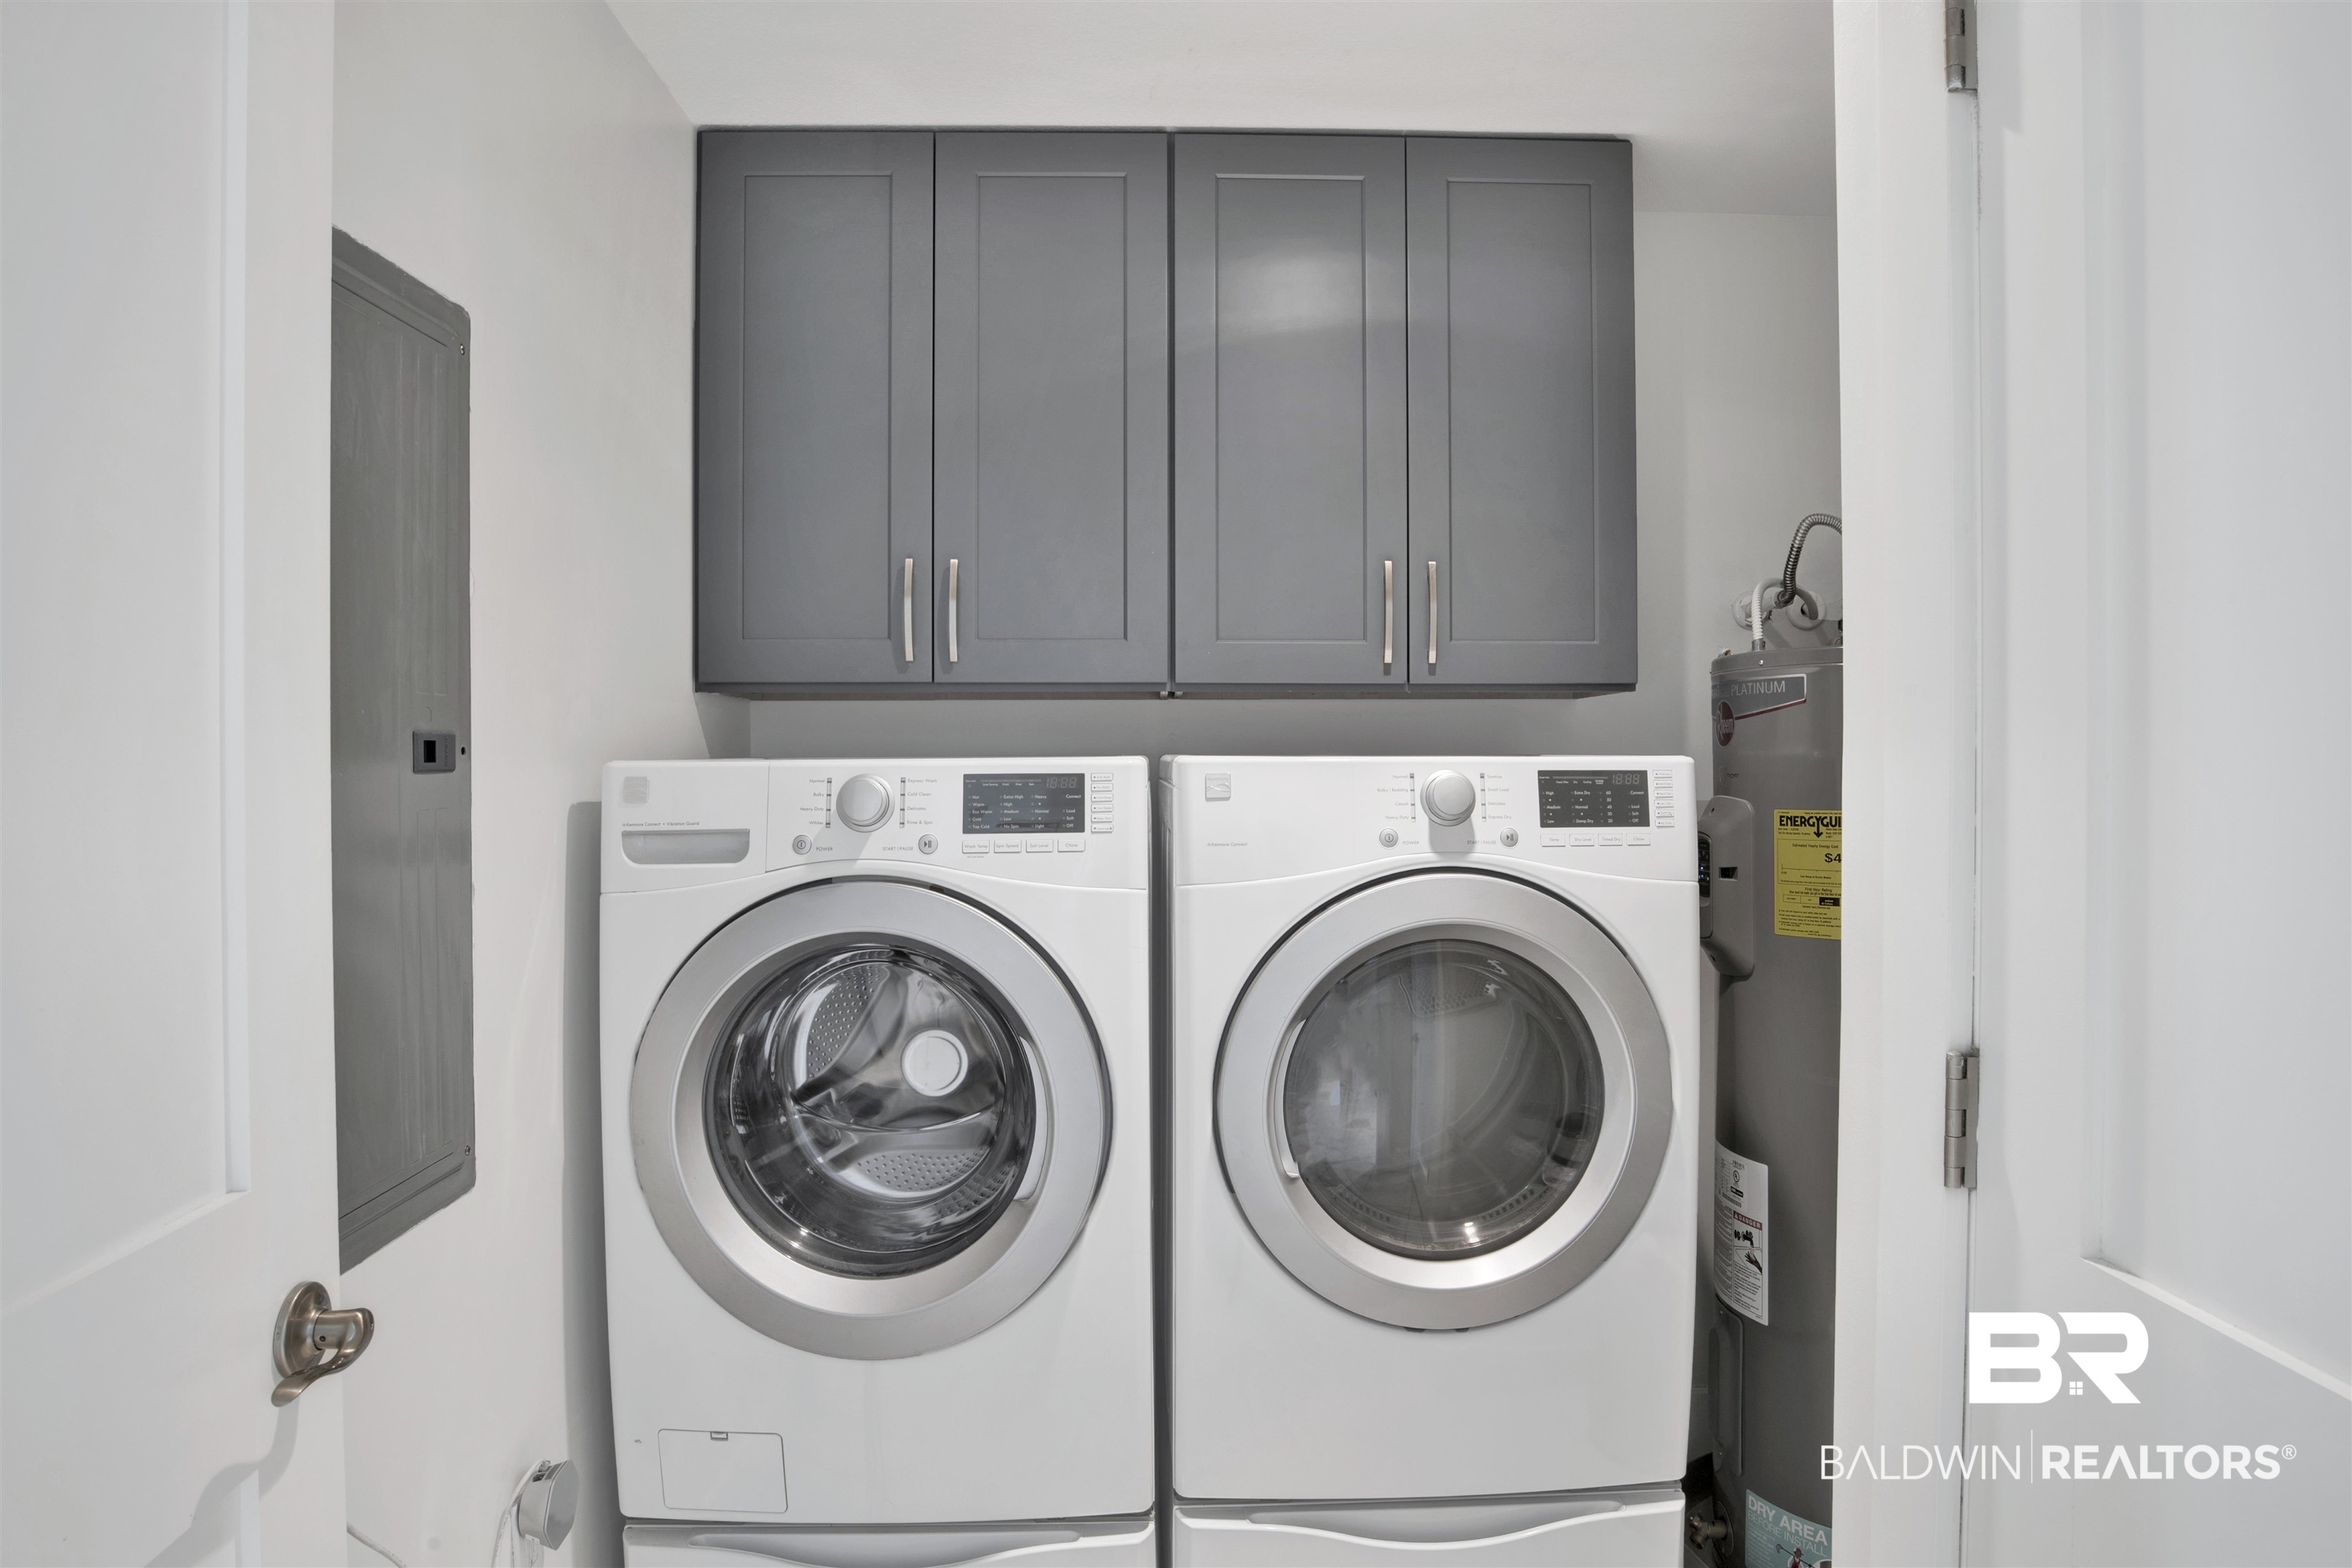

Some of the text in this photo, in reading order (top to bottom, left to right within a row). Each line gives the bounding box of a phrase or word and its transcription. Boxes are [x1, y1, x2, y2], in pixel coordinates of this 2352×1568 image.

[1731, 680, 1785, 696] PLATINUM
[1739, 1215, 1761, 1229] DANGER
[1748, 1495, 1776, 1522] DRY
[1779, 1515, 1828, 1546] AREA
[1748, 1510, 1781, 1538] BEFORE
[1784, 1531, 1827, 1557] INSTALL
